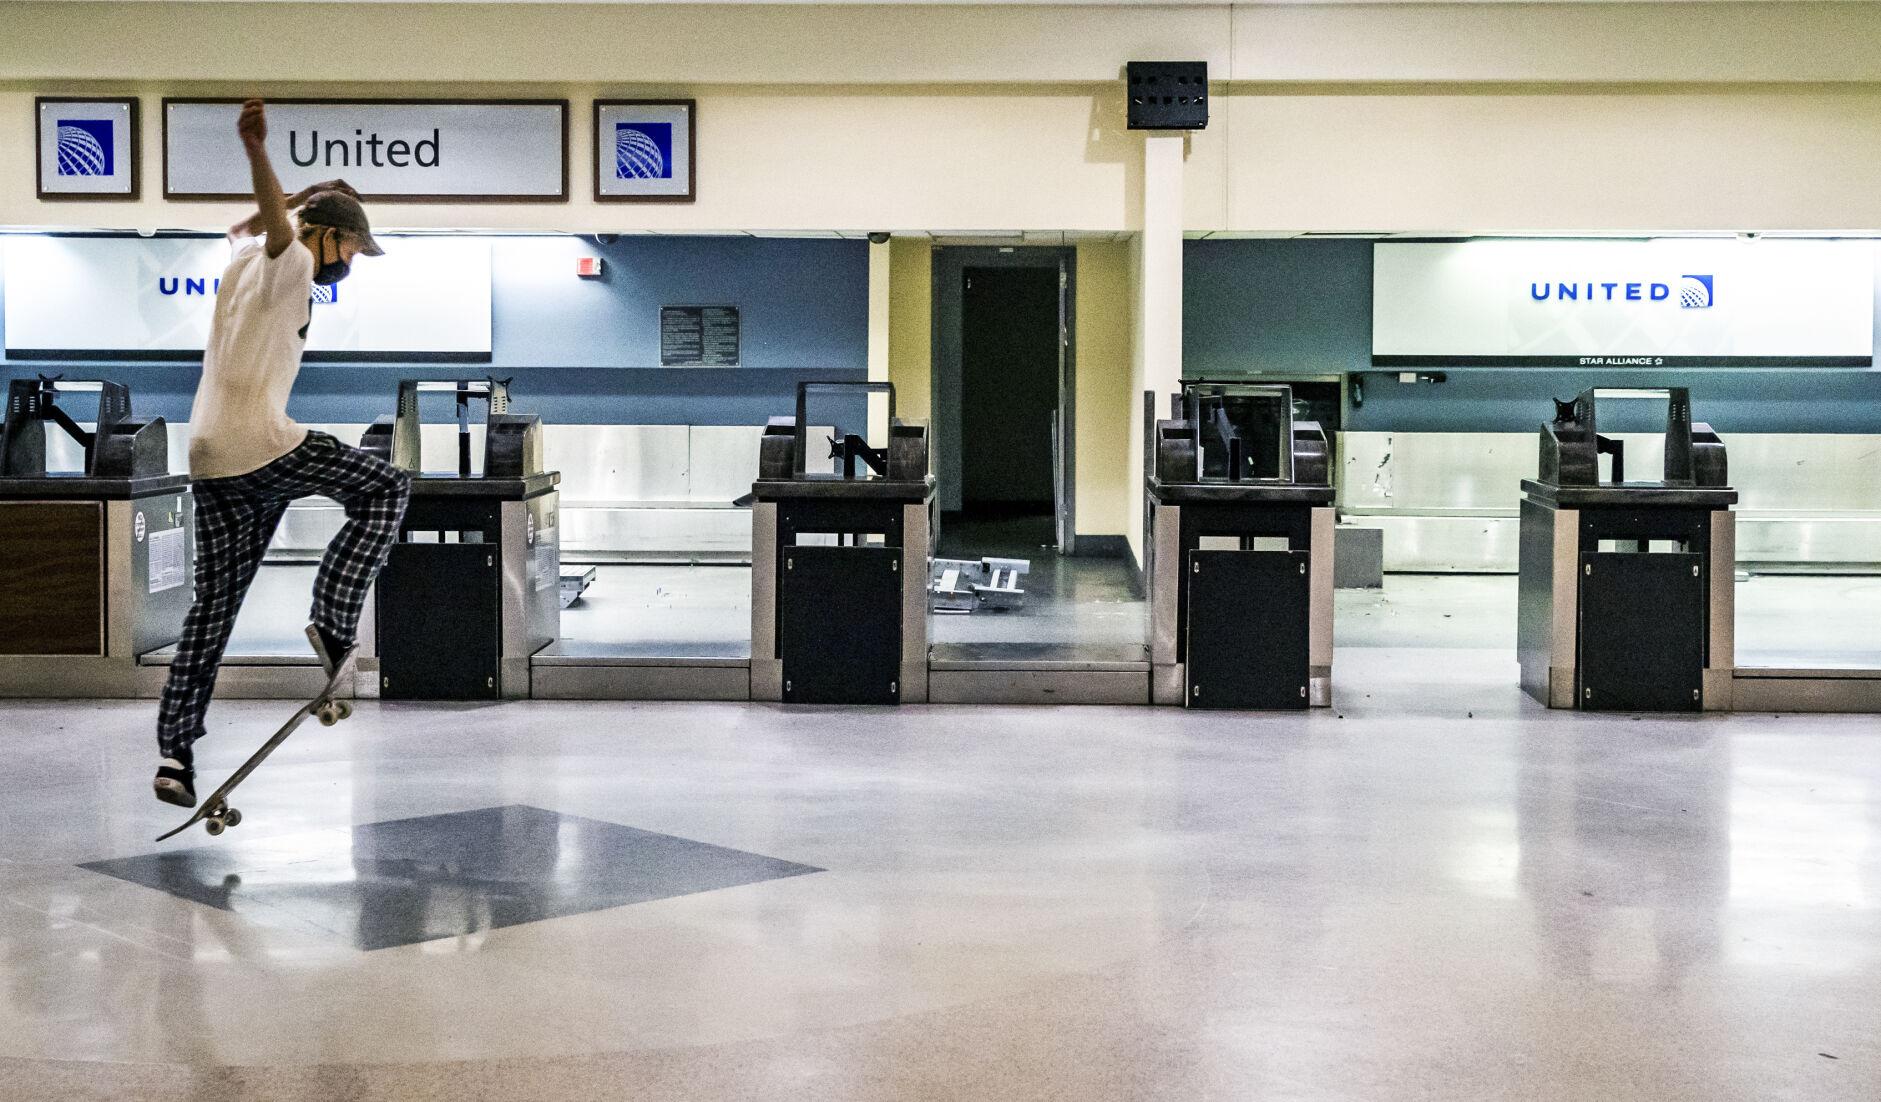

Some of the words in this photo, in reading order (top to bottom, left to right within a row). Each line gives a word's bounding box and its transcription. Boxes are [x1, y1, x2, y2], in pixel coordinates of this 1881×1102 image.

[290, 128, 440, 167] United
[159, 277, 220, 296] UNI
[1531, 282, 1670, 301] UNITED
[1579, 357, 1604, 366] STAR
[1605, 357, 1653, 366] ALLIANCE
